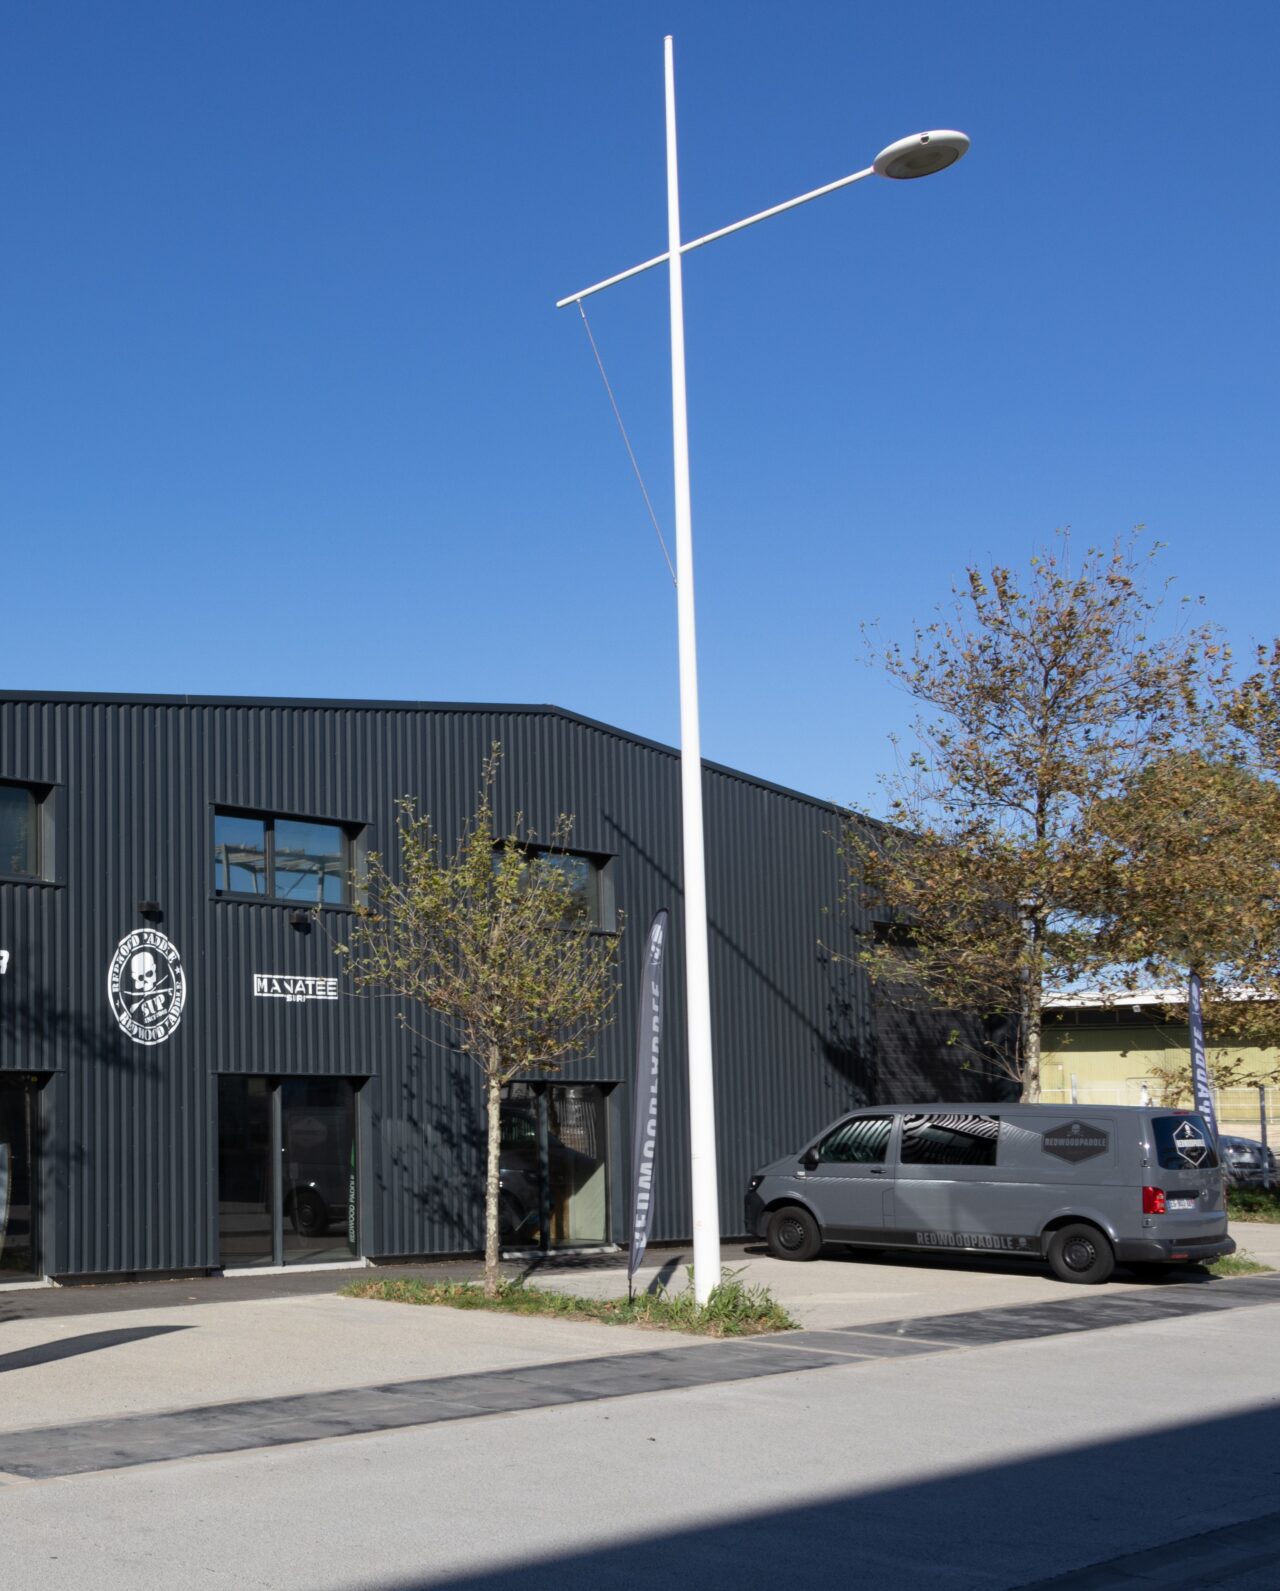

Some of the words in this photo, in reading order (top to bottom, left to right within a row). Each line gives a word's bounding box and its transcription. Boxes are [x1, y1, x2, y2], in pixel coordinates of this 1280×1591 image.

[257, 978, 337, 996] MANATEE
[141, 994, 166, 1017] SUP
[1044, 1137, 1106, 1148] REDWOODPADDLE
[916, 1231, 1015, 1250] REDWOODPADDLE
